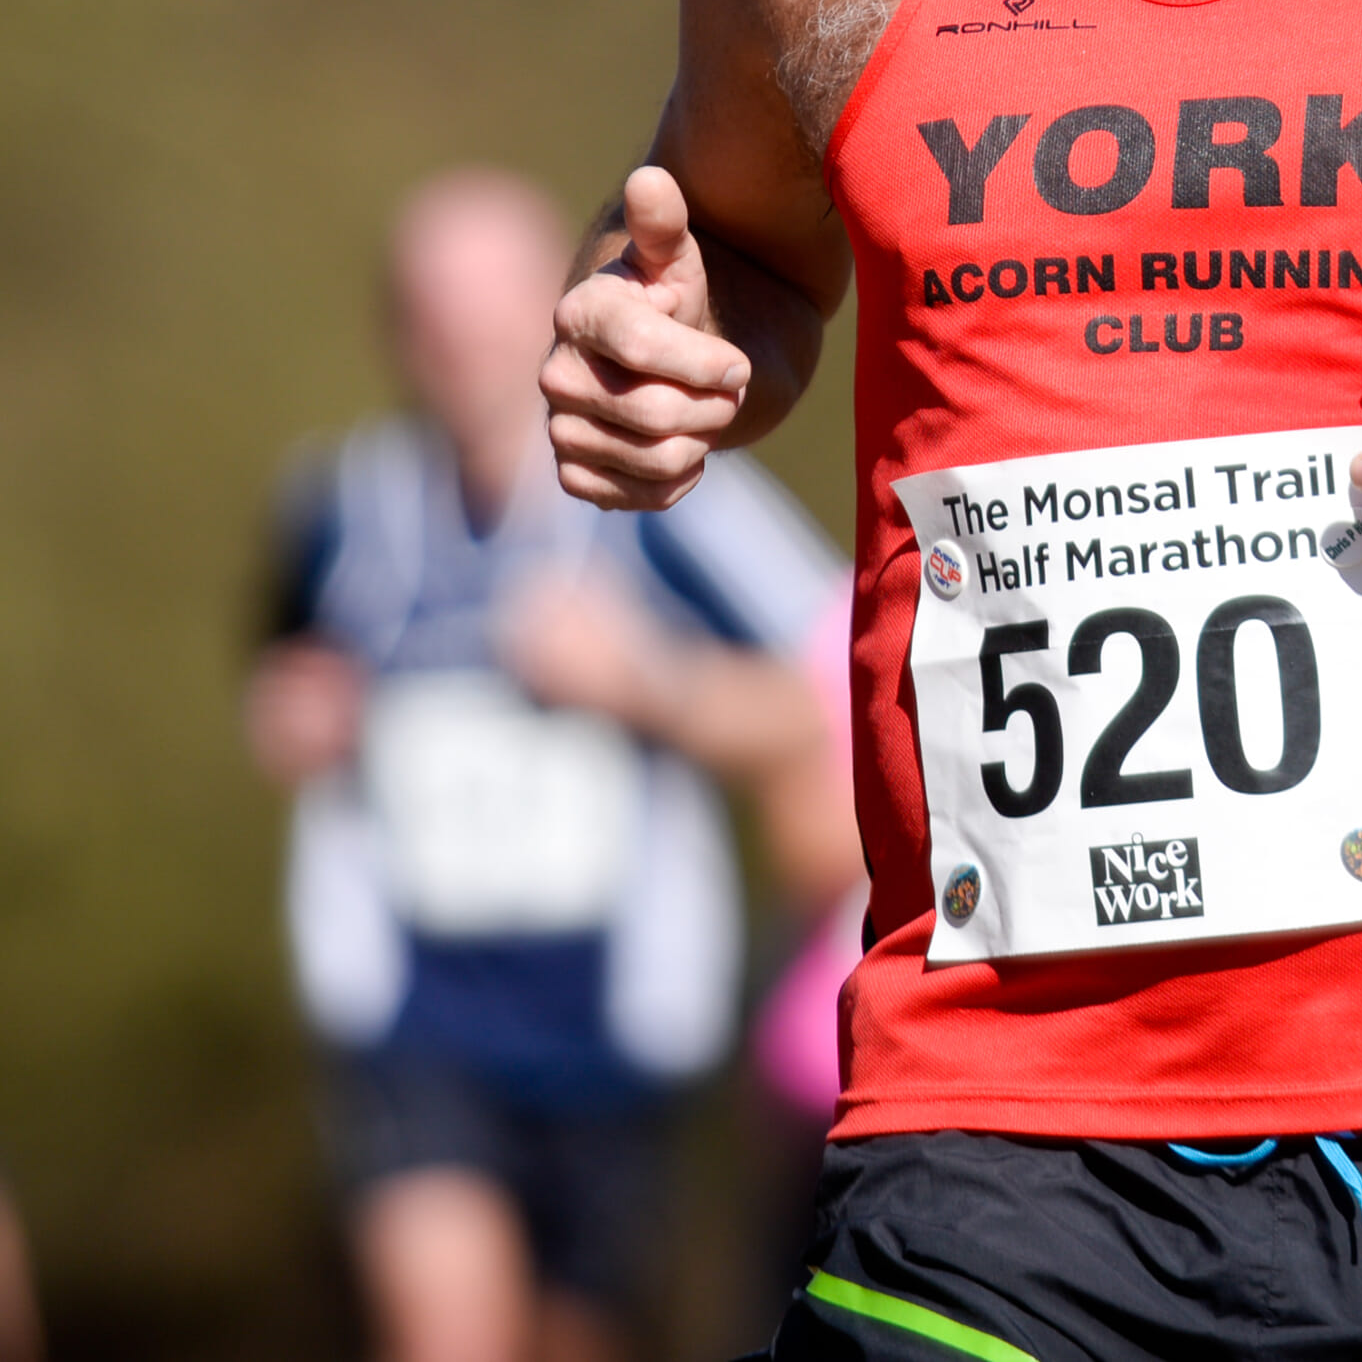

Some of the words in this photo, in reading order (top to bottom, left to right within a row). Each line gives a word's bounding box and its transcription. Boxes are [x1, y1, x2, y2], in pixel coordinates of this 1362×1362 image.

[936, 19, 1097, 36] RONHILL
[923, 254, 1115, 307] ACORN
[1084, 312, 1244, 354] CLUB
[943, 493, 1008, 537] The
[1024, 467, 1196, 526] Monsal
[1215, 454, 1336, 504] Trail
[930, 553, 962, 583] CLIP
[933, 546, 960, 569] EVENT
[976, 542, 1050, 593] Half
[1066, 525, 1318, 581] Marathon
[1325, 537, 1350, 560] Chris
[980, 594, 1321, 818] 520
[1100, 832, 1189, 884] Nice
[1094, 867, 1203, 923] Work
